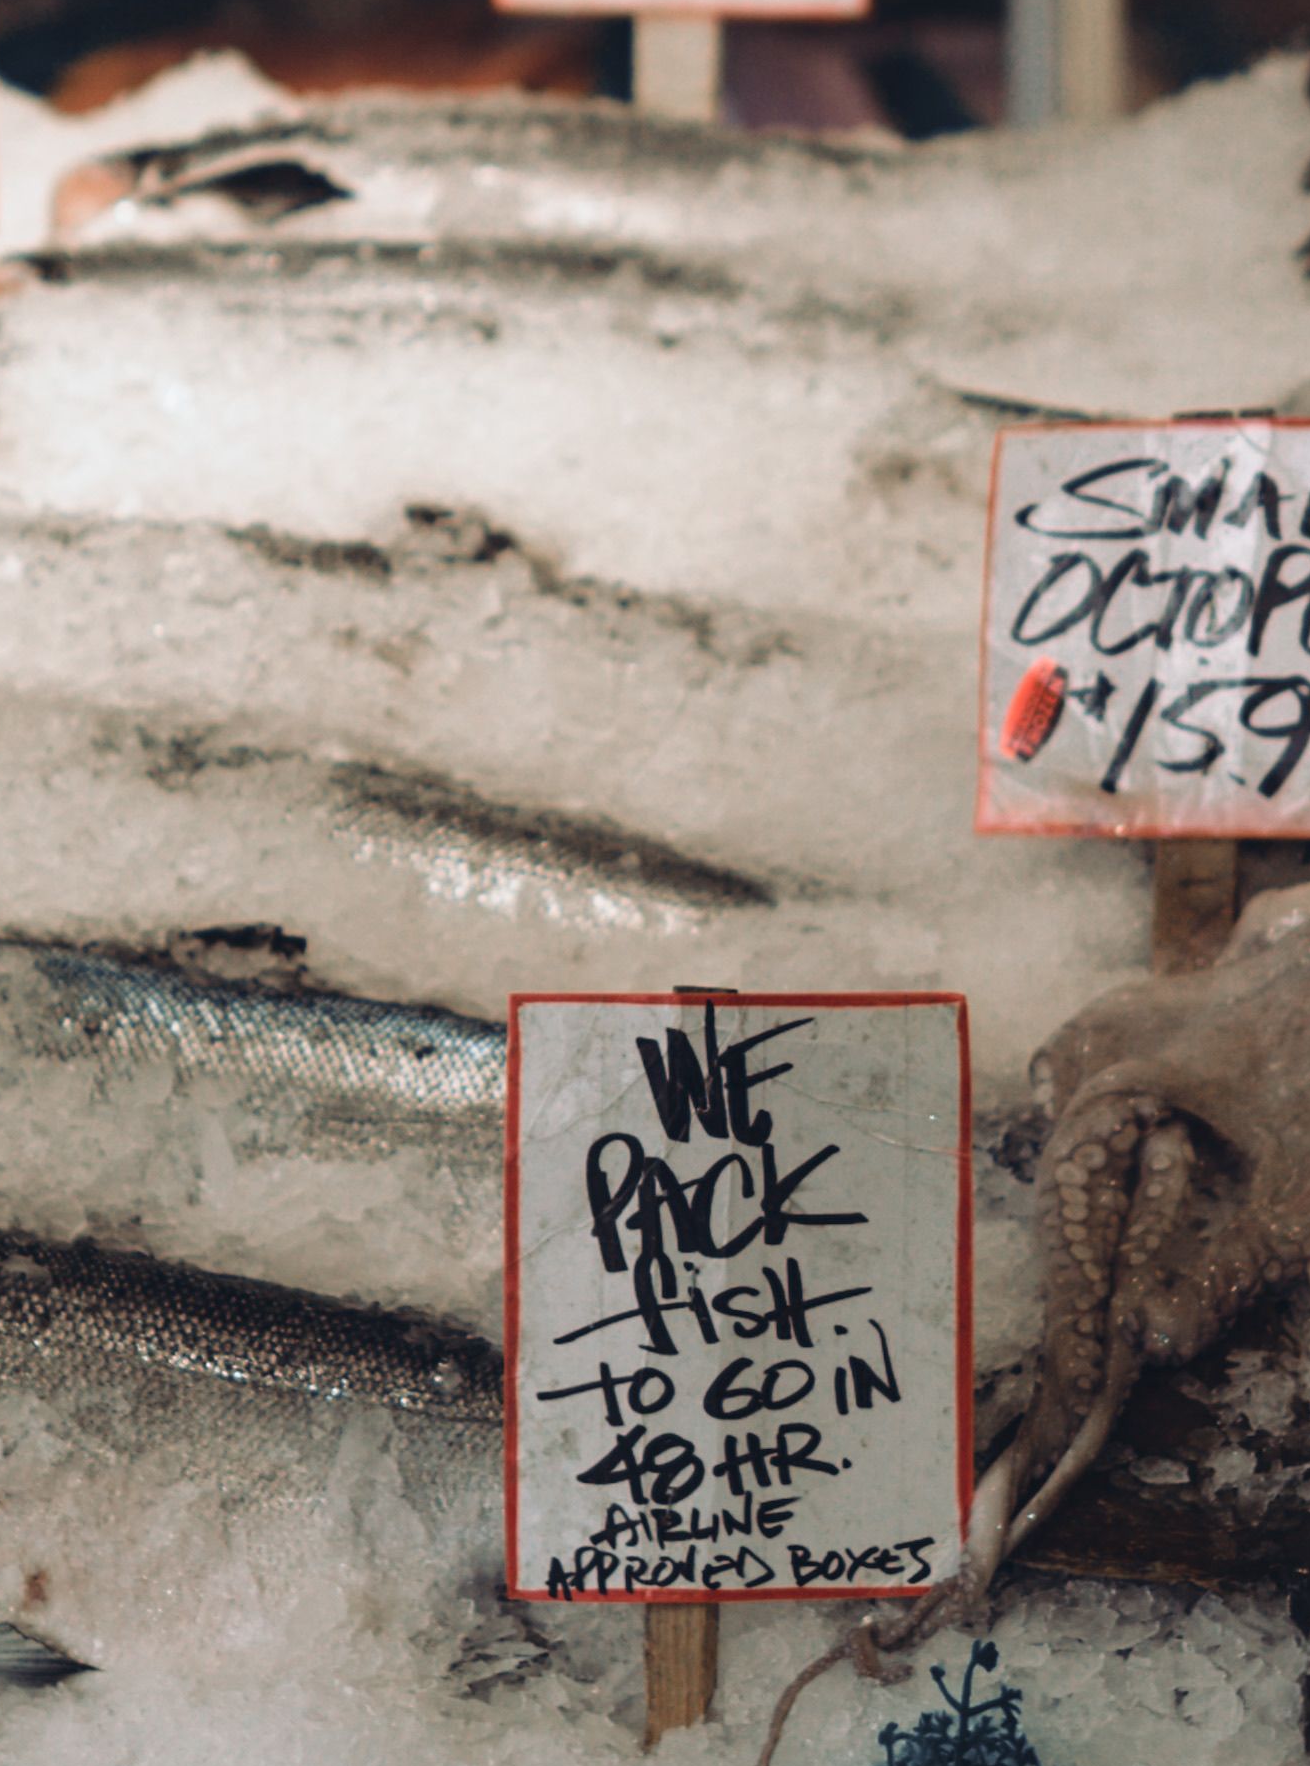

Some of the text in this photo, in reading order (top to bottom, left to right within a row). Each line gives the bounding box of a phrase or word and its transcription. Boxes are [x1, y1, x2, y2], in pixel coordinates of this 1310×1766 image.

[635, 999, 815, 1146] WE
[586, 1132, 869, 1273] PACK
[537, 1360, 676, 1426] TO
[703, 1356, 817, 1420] GO
[590, 1491, 802, 1549] AIRLINE
[545, 1536, 935, 1601] APPROVED BOXES
